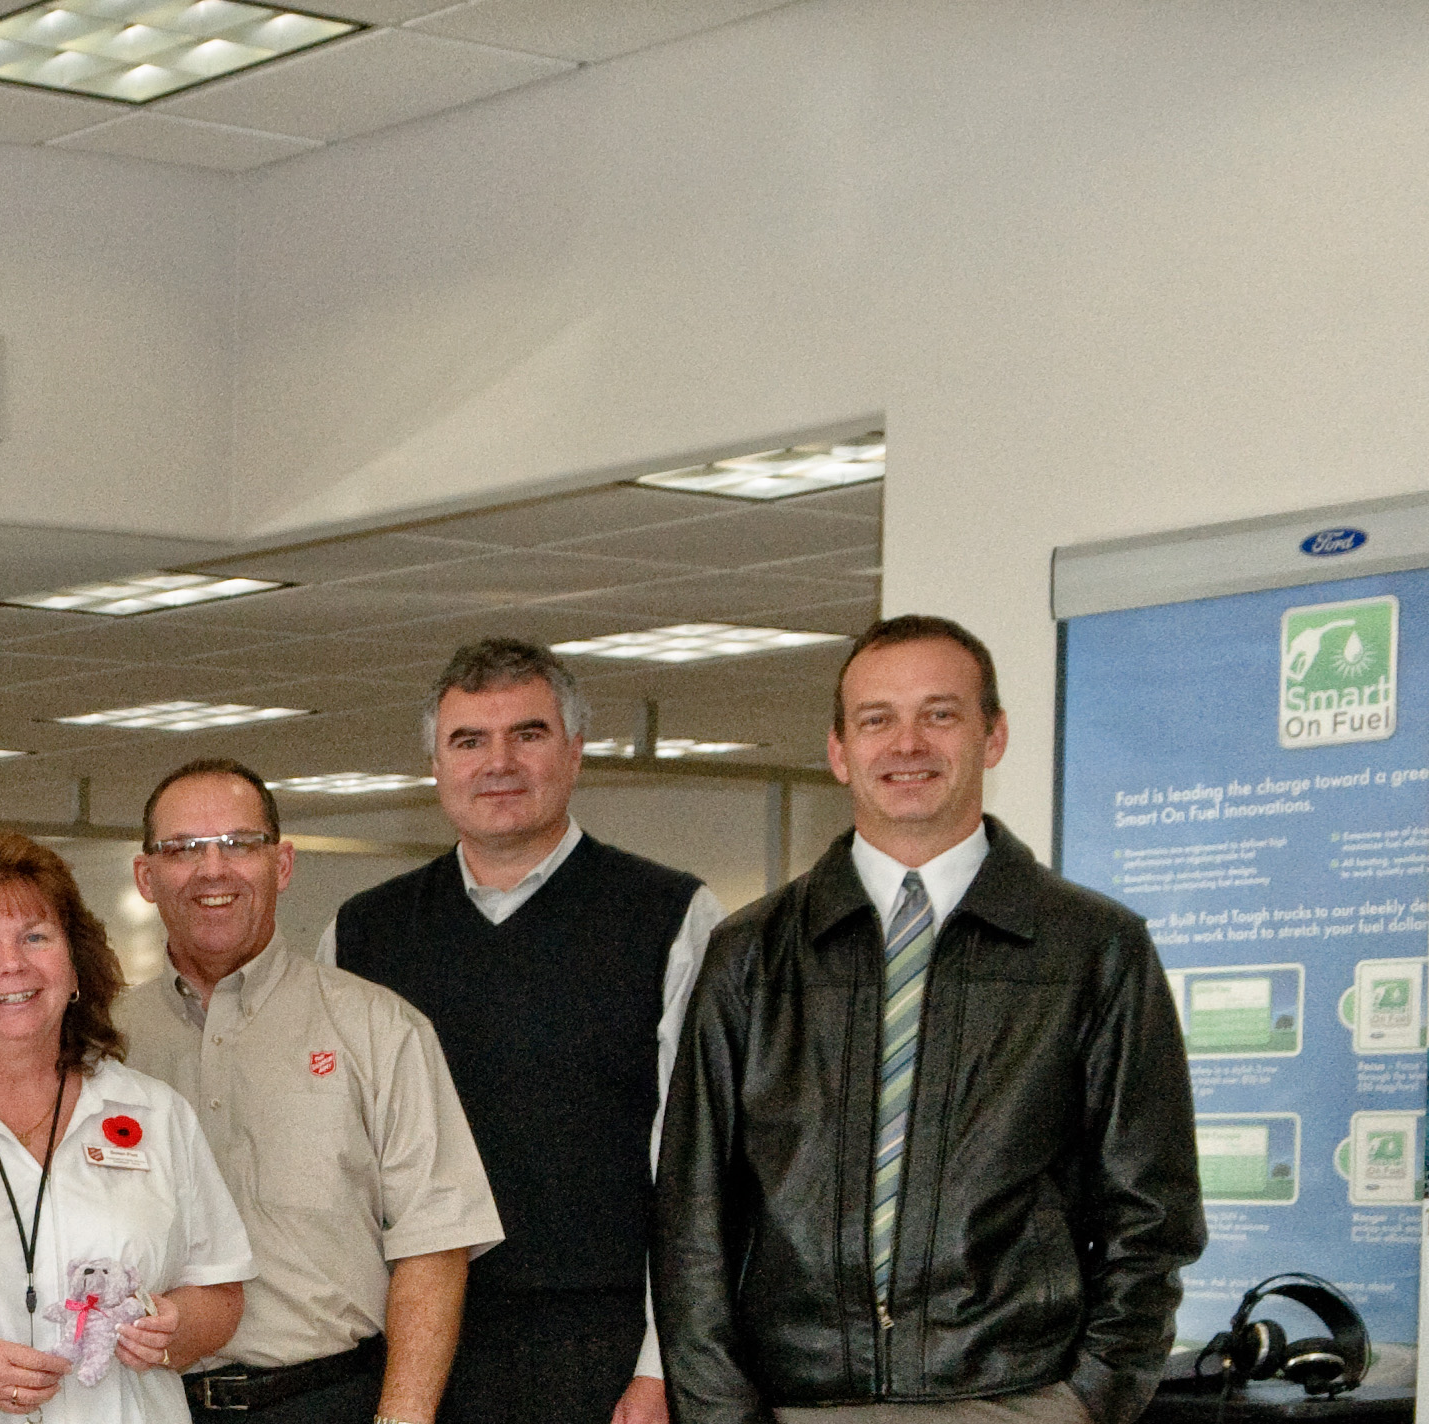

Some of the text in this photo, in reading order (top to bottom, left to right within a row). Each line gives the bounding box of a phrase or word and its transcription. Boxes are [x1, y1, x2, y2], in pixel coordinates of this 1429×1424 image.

[1309, 530, 1357, 554] Ford
[1286, 675, 1390, 712] Smart
[1285, 705, 1390, 738] On Fuel
[1115, 787, 1149, 807] Ford
[1152, 787, 1164, 804] is
[1167, 783, 1223, 804] leading
[1227, 779, 1252, 797] the
[1256, 776, 1311, 796] charge
[1315, 767, 1370, 789] toward
[1374, 771, 1387, 785] a
[1115, 810, 1158, 828] Smart
[1161, 807, 1185, 824] On
[1189, 804, 1220, 822] Fuel
[1198, 909, 1228, 926] Ford
[1232, 907, 1269, 926] Tough
[1273, 903, 1312, 920] trucks
[1315, 906, 1329, 918] to
[1331, 906, 1355, 918] our
[1359, 899, 1406, 918] sleekly
[1193, 927, 1223, 943] work
[1227, 926, 1258, 941] hard
[1261, 927, 1274, 939] to
[1278, 922, 1320, 939] stretch
[1323, 924, 1355, 940] your
[1358, 918, 1384, 933] fuel
